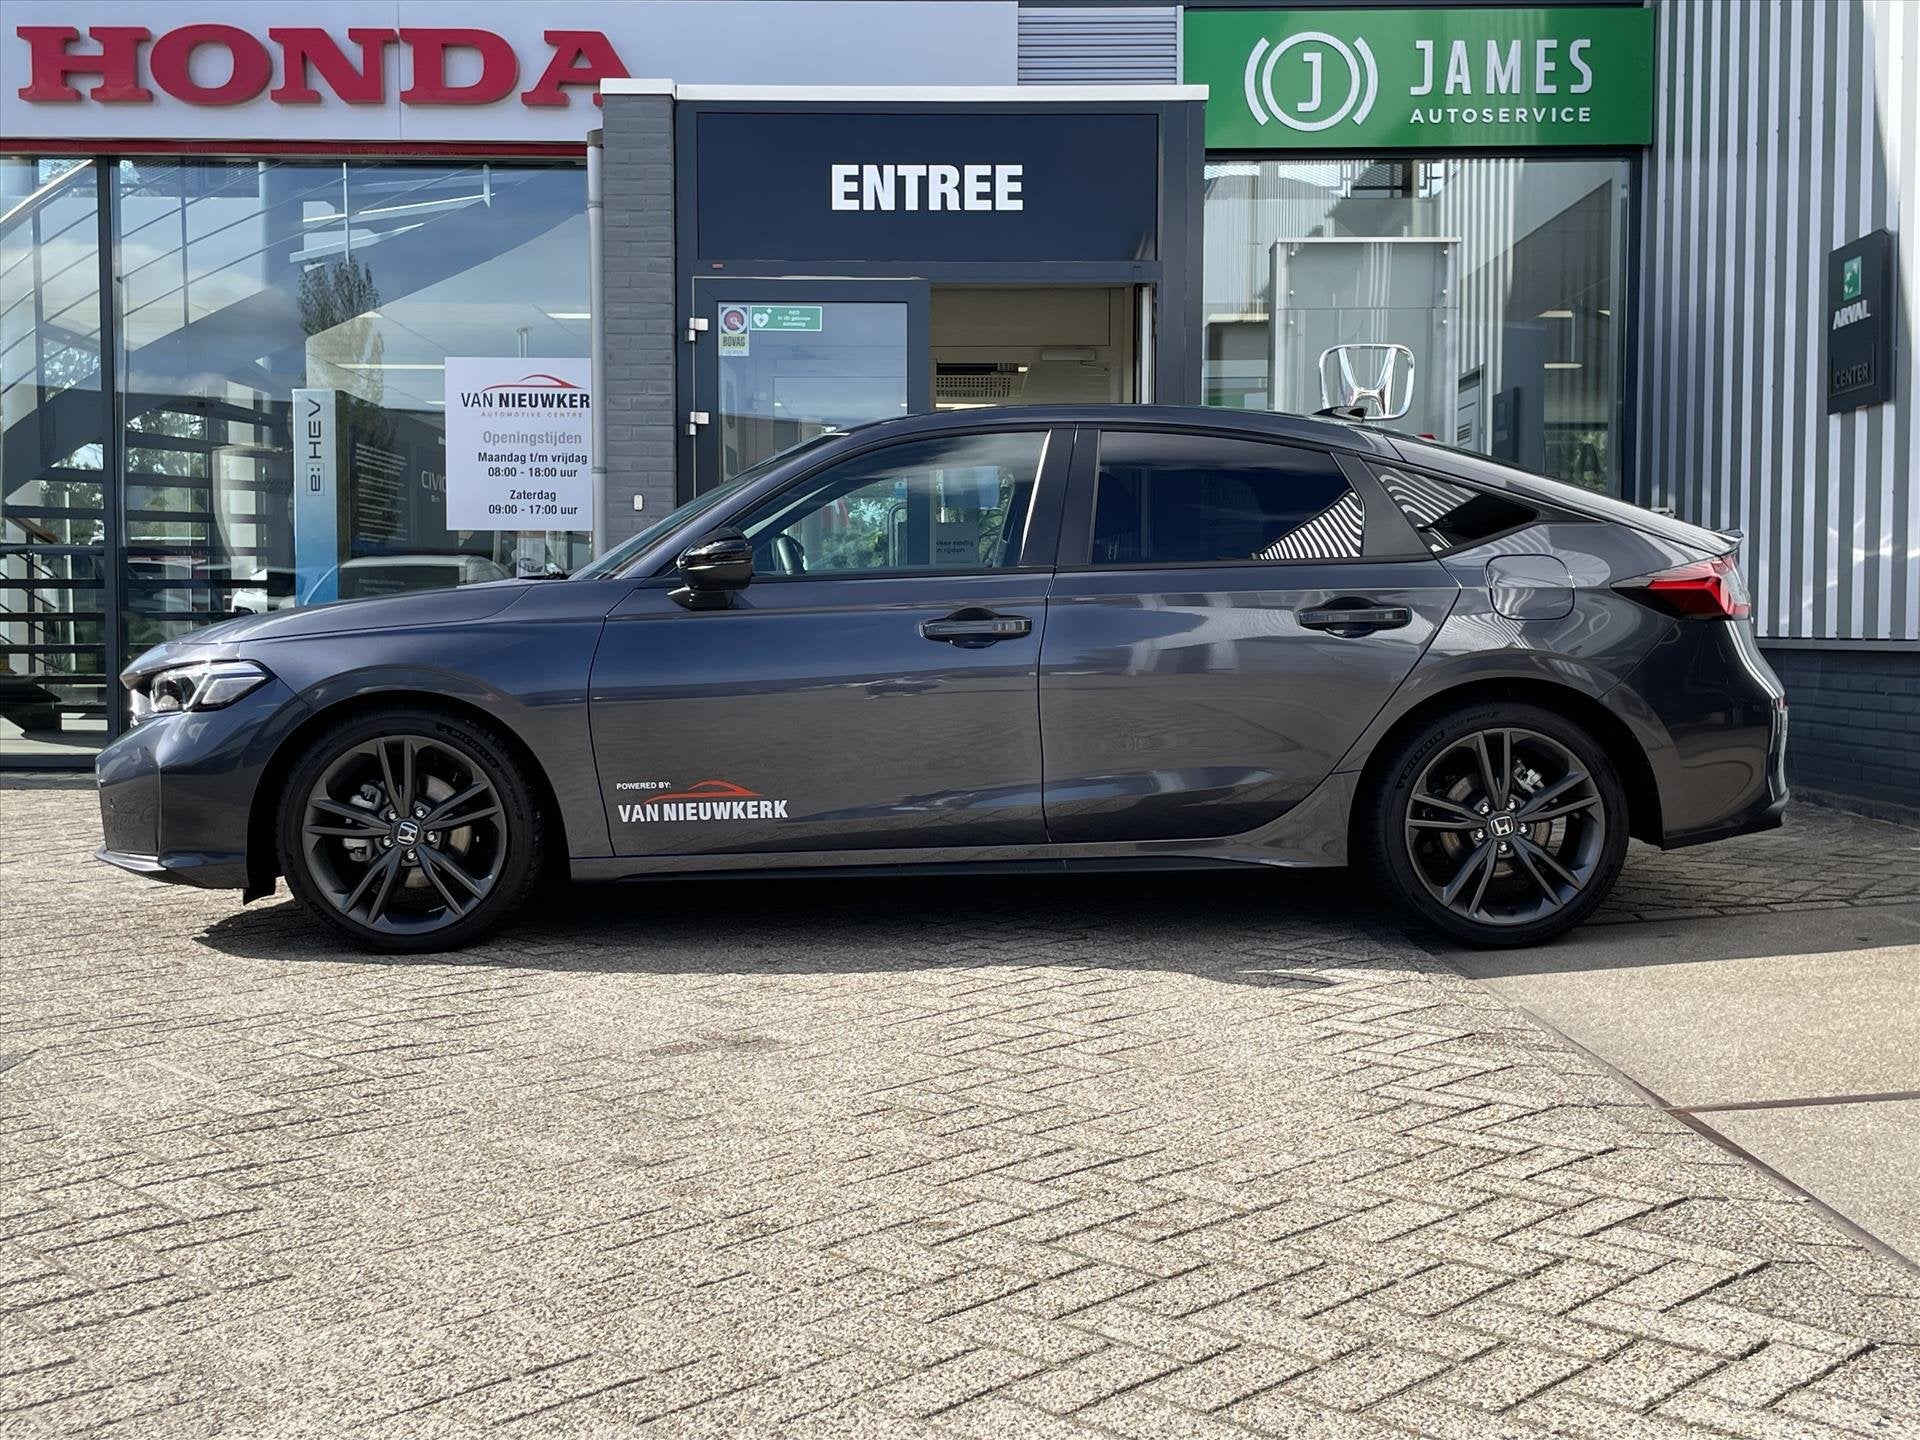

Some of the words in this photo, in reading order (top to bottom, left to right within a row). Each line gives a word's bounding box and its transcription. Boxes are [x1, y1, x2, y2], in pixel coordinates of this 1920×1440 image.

[16, 23, 633, 107] HONDA
[1409, 39, 1594, 96] JAMES
[1409, 107, 1591, 124] AUTOSERVICE
[831, 164, 1024, 211] ENTREE
[1832, 300, 1871, 330] ARVAL
[1834, 363, 1869, 388] CENTER
[460, 391, 493, 408] VAN
[498, 392, 591, 409] NIEUWKER
[546, 411, 583, 419] CENTRE
[482, 430, 582, 446] Openingstijden
[478, 451, 526, 465] Maandag
[529, 452, 548, 463] t/m
[551, 452, 588, 465] vrijdag
[487, 466, 517, 477] 08:00
[528, 466, 557, 477] 18:00
[560, 468, 578, 478] uur
[509, 489, 557, 502] Zaterdag
[488, 504, 518, 515] 09:00
[529, 504, 558, 515] 17:00
[560, 506, 579, 515] uur
[616, 781, 657, 790] POWERED
[658, 781, 672, 789] BY:
[617, 803, 659, 823] VAN
[663, 799, 789, 822] NIEUWKERK
